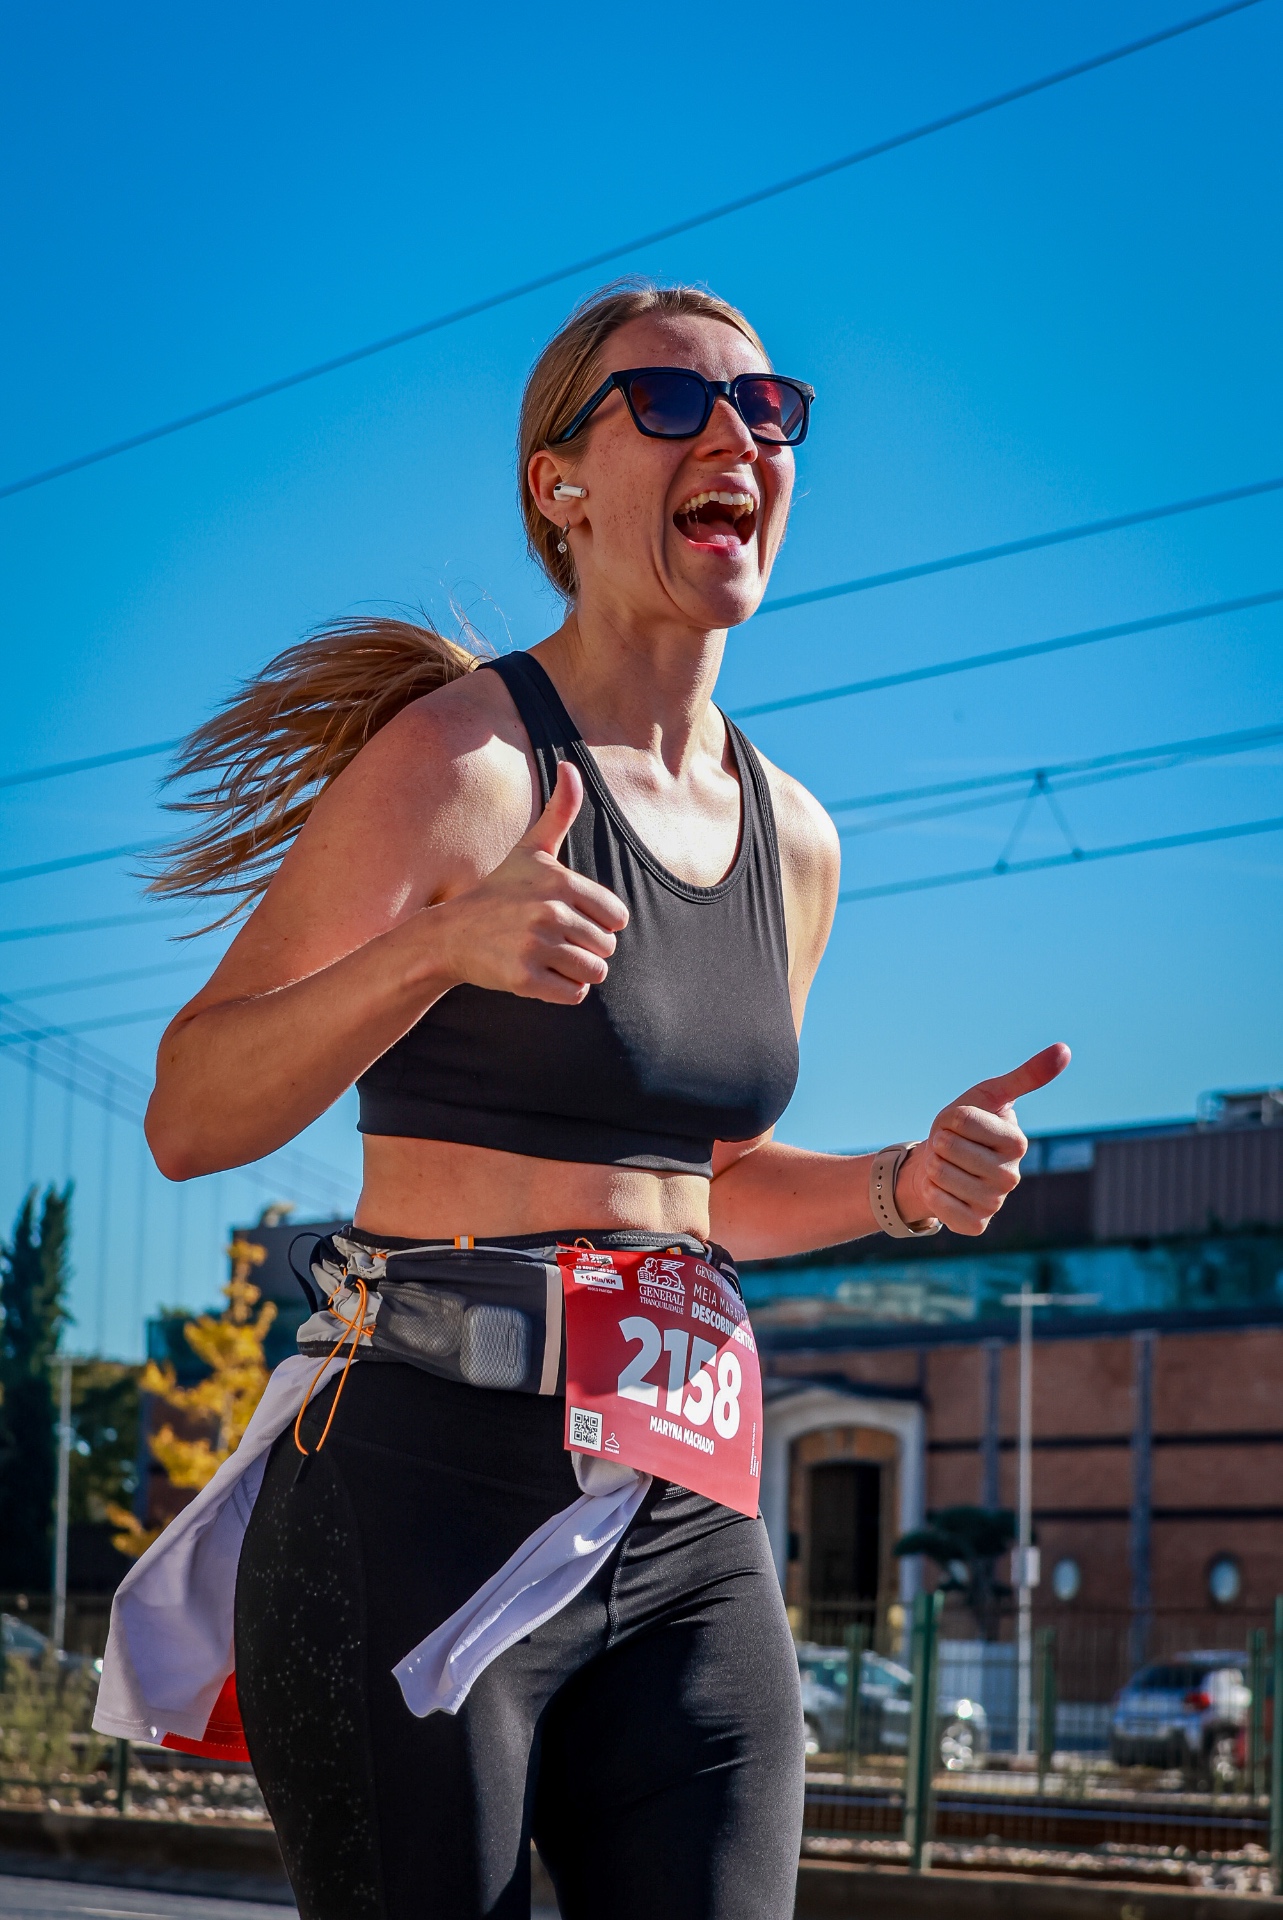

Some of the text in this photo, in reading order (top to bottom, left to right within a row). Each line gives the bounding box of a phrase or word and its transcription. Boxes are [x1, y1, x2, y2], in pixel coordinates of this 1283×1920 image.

[639, 1285, 685, 1307] GENERALI
[639, 1296, 684, 1315] TRANQUILIDADE
[693, 1282, 718, 1308] MEIA
[691, 1301, 755, 1354] DESCOBRIMENTOS
[617, 1316, 742, 1440] 2158
[649, 1415, 715, 1456] MARYNA MACHADO
